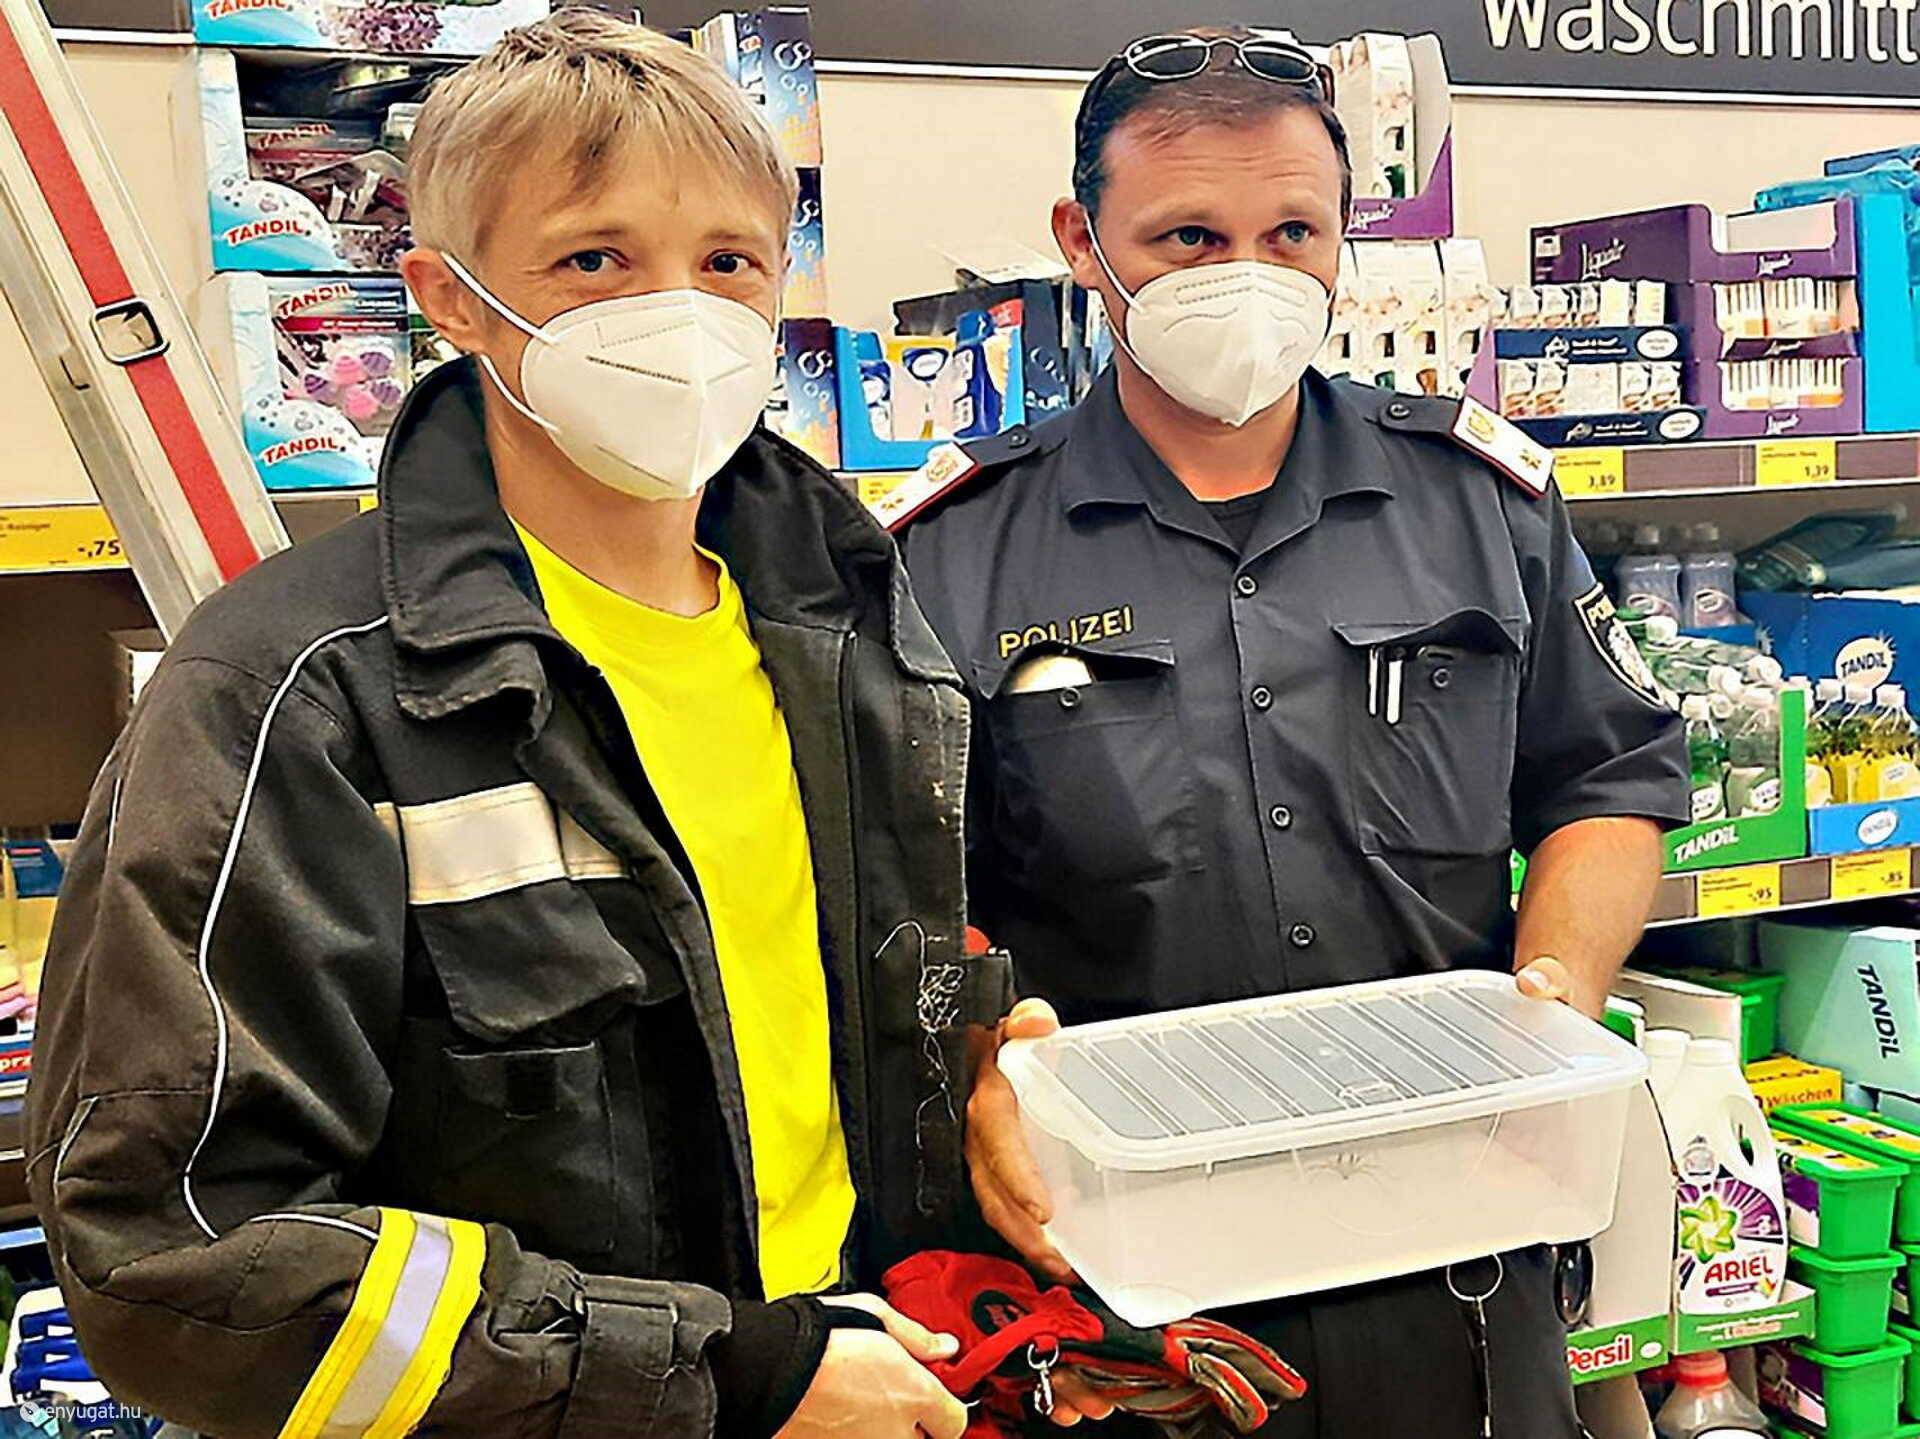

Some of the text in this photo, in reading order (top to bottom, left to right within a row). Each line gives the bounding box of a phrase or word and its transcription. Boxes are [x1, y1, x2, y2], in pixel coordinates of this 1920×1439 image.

[227, 220, 304, 244] TANDIL
[263, 437, 338, 463] TANDIL
[77, 539, 120, 558] -,75
[998, 605, 1133, 659] POLIZEI
[1704, 1256, 1774, 1284] ARIEL
